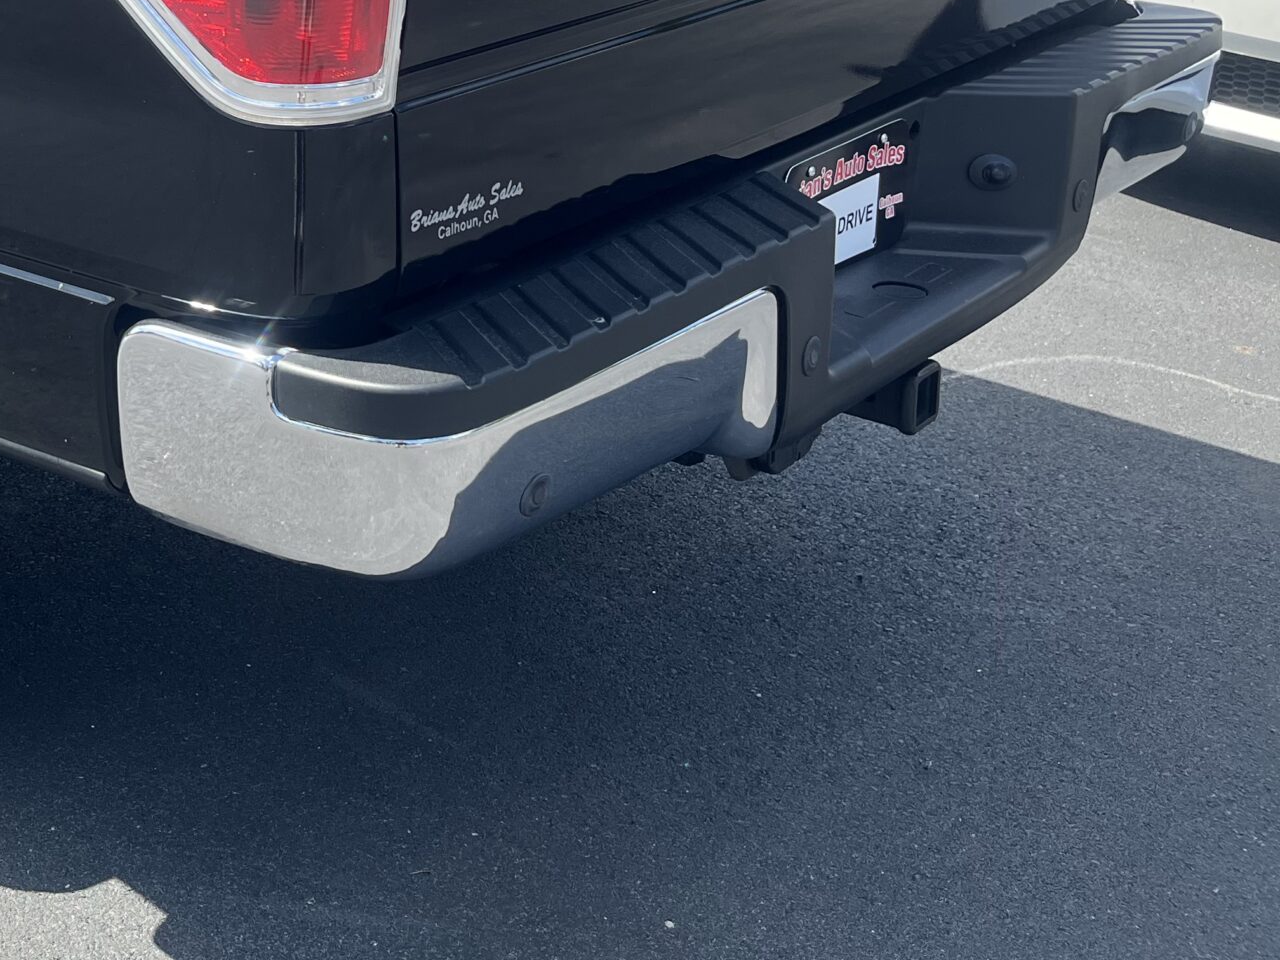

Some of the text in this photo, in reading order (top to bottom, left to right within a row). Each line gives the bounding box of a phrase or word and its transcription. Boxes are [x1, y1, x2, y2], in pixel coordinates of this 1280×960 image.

[833, 151, 866, 186] Auto
[866, 141, 906, 171] Sales
[410, 179, 524, 233] Brians Auto Sales
[437, 207, 500, 240] Calhoun, GA
[837, 203, 874, 235] DRIVE
